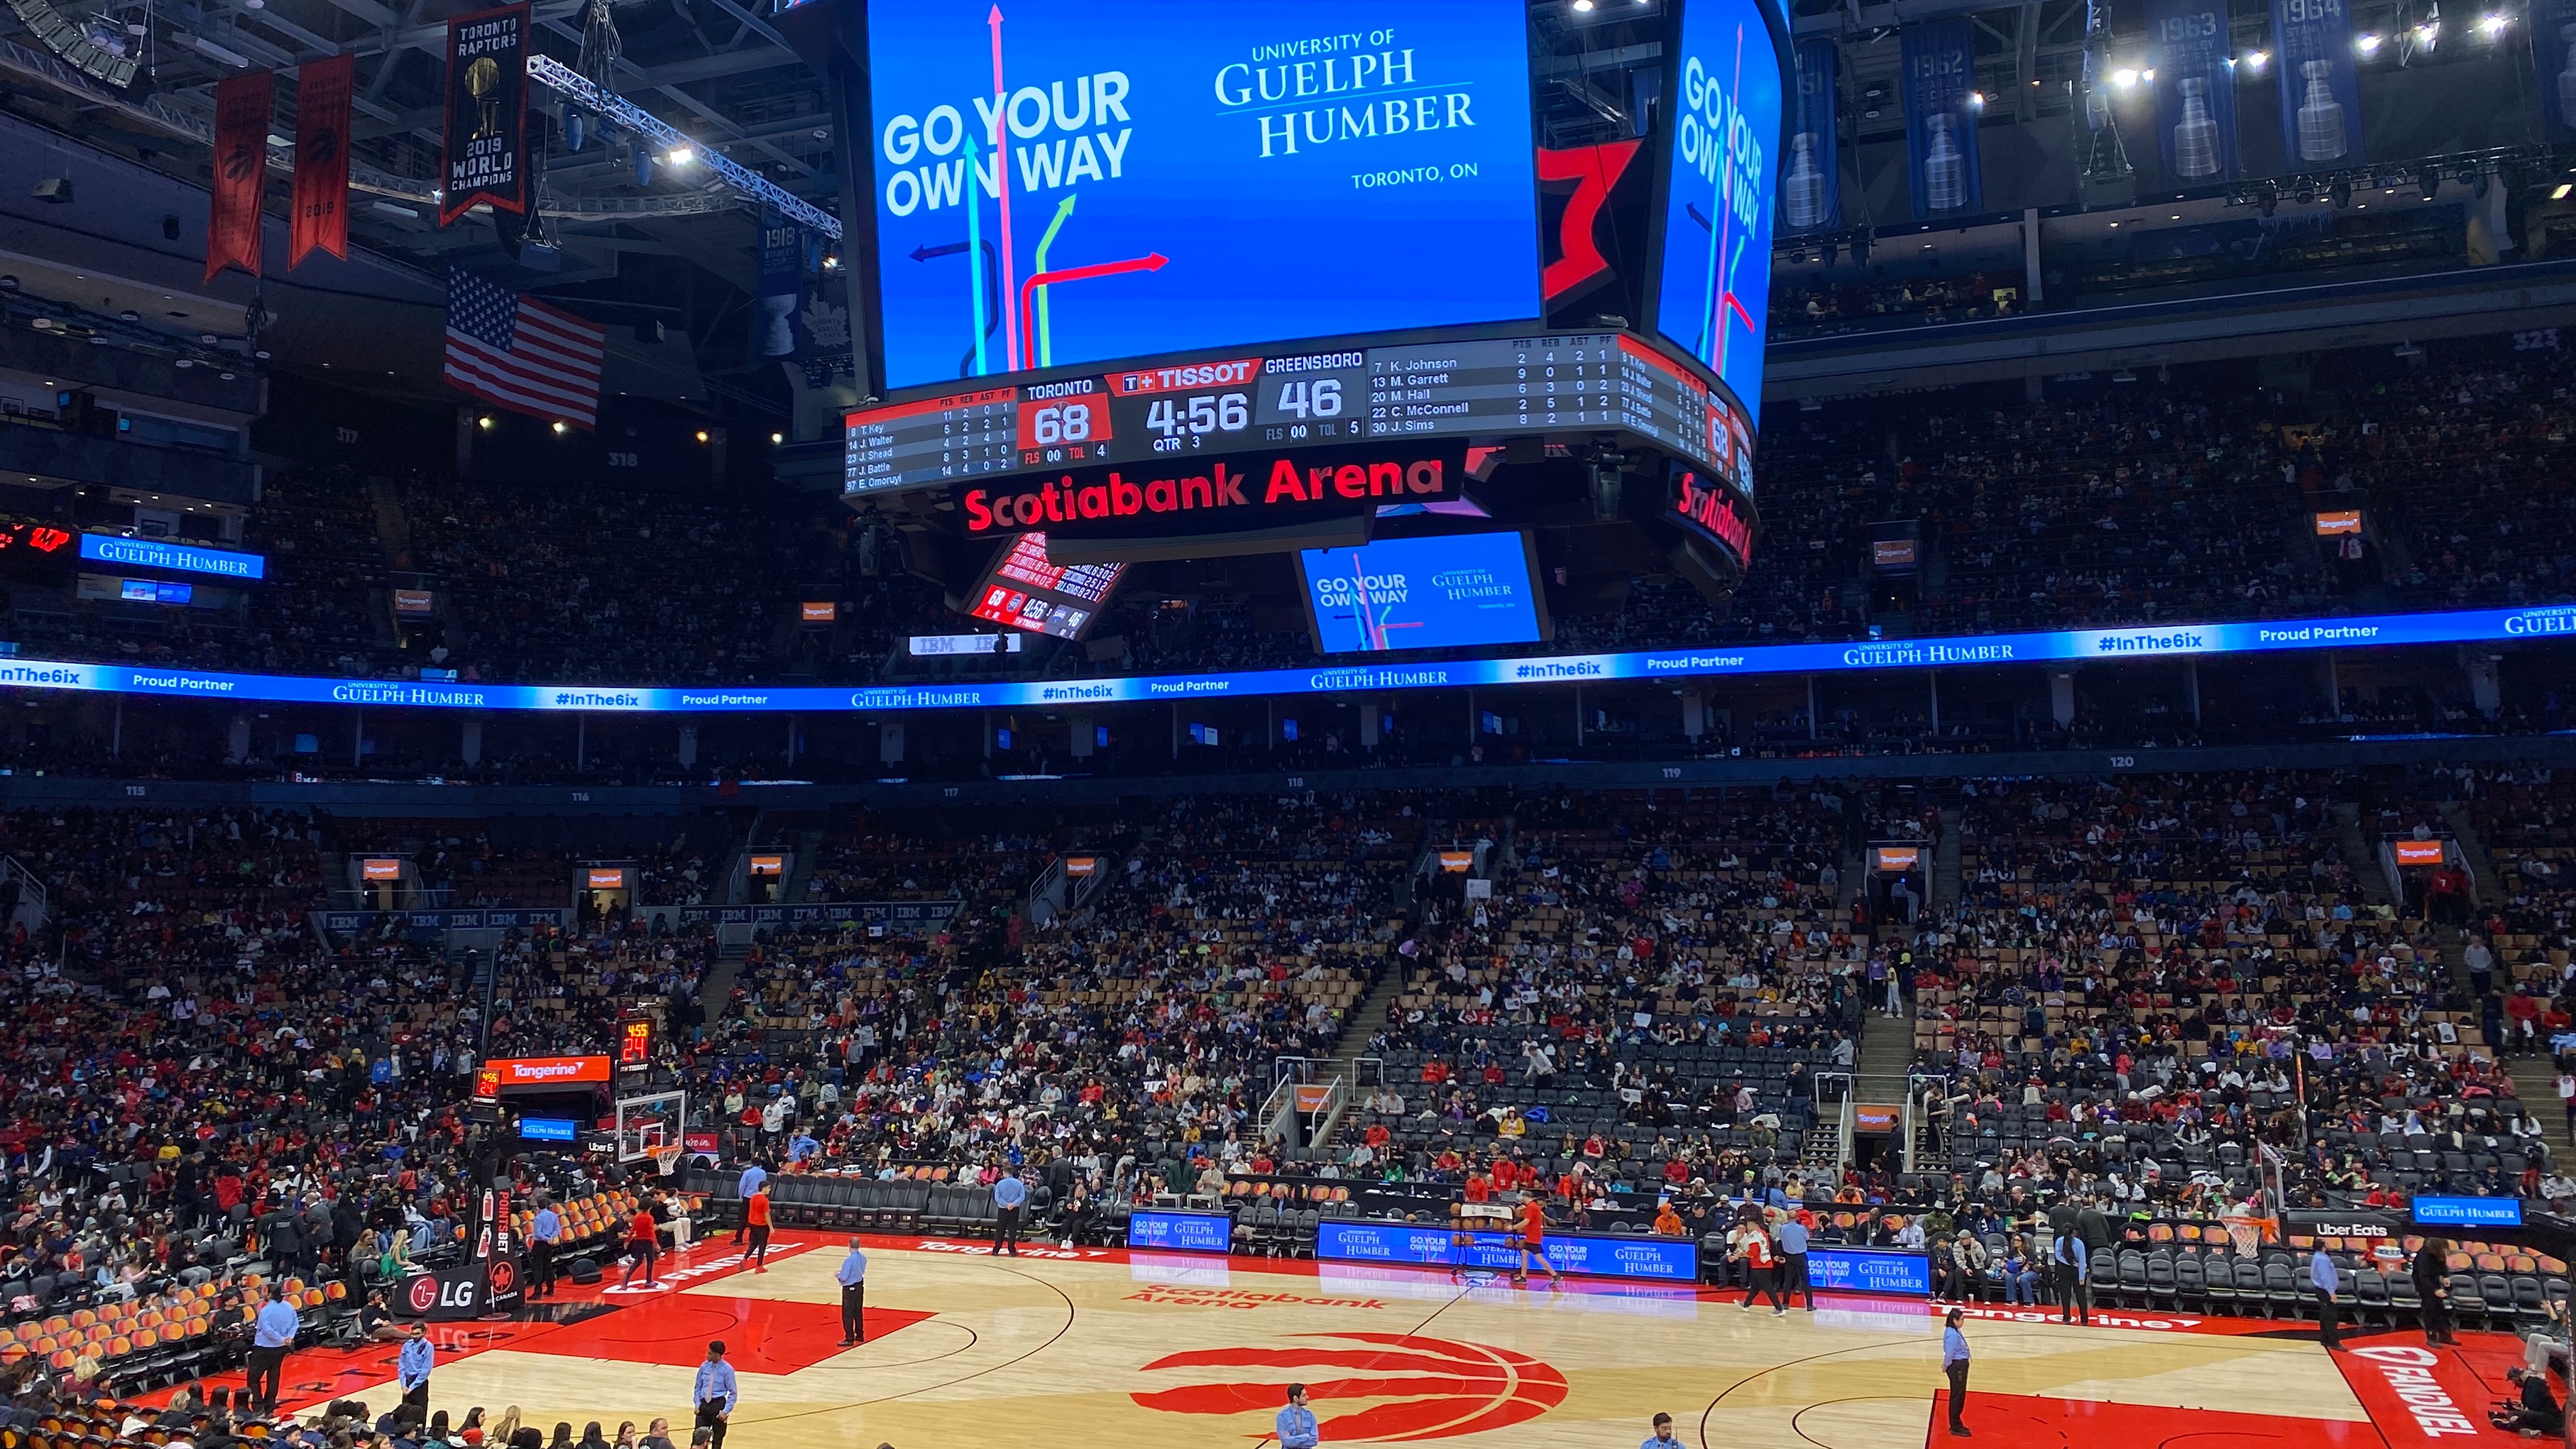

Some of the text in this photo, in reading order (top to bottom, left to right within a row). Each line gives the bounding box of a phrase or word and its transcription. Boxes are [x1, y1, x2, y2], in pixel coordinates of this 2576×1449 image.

[2281, 0, 2340, 23] 1964
[461, 18, 517, 40] TORONTO
[2159, 11, 2216, 43] 1963
[458, 33, 517, 56] RAPTORS
[1252, 29, 1395, 62] UNIVERSITY OF
[1914, 50, 1963, 78] 1962
[1214, 48, 1416, 106] GUELPH
[883, 70, 1131, 165] GO YOUR
[1258, 92, 1476, 158] HUMBER
[1685, 56, 1762, 197] GO YOUR
[466, 137, 502, 158] 2019
[452, 151, 513, 178] WORLD
[451, 171, 512, 190] CHAMPIONS
[886, 129, 1132, 217] OWN WAY
[1352, 163, 1477, 189] TORONTO, ON
[1681, 114, 1759, 241] OWN WAY
[306, 201, 334, 219] 2019
[766, 226, 795, 248] 1918
[764, 248, 795, 259] STANLEY
[772, 257, 787, 266] CUP
[1512, 335, 1611, 349] PTS REB AST PF
[2514, 329, 2557, 351] 323
[1265, 352, 1363, 374] GREENSBORO
[1375, 358, 1457, 373] 7 K. Johnson
[1157, 362, 1250, 388] TISSOT
[1371, 373, 1449, 388] 13 M. Garrett
[1027, 380, 1093, 400] TORONTO
[1278, 378, 1342, 417] 46
[1371, 389, 1430, 402] 20 M. Hall
[1146, 393, 1248, 437] 4:56
[1371, 402, 1469, 419] 22 C. McConnell
[850, 423, 884, 437] 8 T. Key
[1035, 404, 1090, 444] 68
[1372, 420, 1435, 433] 30 J. Sims
[336, 427, 358, 444] 317
[848, 434, 894, 450] 14 J. Walter
[1153, 436, 1200, 452] QTR 3
[608, 452, 638, 467] 318
[847, 448, 893, 464] 23 J. Shead
[847, 462, 890, 478] 77 J. Battle
[846, 474, 902, 491] 97 E. Omoruyi
[965, 459, 1443, 531] Scotiabank Arena
[114, 540, 157, 551] UNIVERSITY
[99, 542, 248, 575] GUELPH-HUMBER
[1316, 574, 1407, 594] GO YOUR
[1432, 574, 1493, 587] GUELPH
[988, 589, 1007, 607] 68
[1320, 589, 1408, 607] OWN WAY
[1447, 585, 1513, 601] HUMBER
[1068, 611, 1084, 628] 46
[2099, 632, 2203, 651] #InThe6ix
[2259, 625, 2379, 643] Proud Partner
[920, 637, 955, 652] IBM
[1858, 643, 1901, 652] UNIVERSITY
[1648, 654, 1744, 670] Proud Partner
[1843, 644, 2015, 666] GUELPH-HUMBER
[1, 667, 80, 684] nThe6ix
[1516, 662, 1601, 678] #InThe6ix
[133, 674, 234, 691] Proud Partner
[1151, 679, 1229, 693] Proud Partner
[1311, 669, 1448, 689] GUELPH-HUMBER
[333, 685, 484, 706] GUELPH-HUMBER
[556, 693, 639, 707] #InThe6ix
[683, 694, 768, 705] Proud Partner
[852, 691, 981, 708] GUELPH-HUMBER
[1043, 684, 1113, 700] #InThe6ix
[2110, 756, 2134, 767] 120
[1662, 767, 1682, 779] 119
[1287, 777, 1304, 787] 118
[126, 785, 146, 797] 115
[571, 792, 590, 802] 116
[943, 787, 959, 797] 117
[2399, 848, 2435, 858] Tangerine
[412, 915, 439, 927] IBM
[451, 914, 478, 926] IBM
[490, 913, 517, 925] IBM
[720, 909, 746, 921] IBM
[757, 909, 782, 921] IBM
[897, 907, 921, 919] IBM
[627, 1024, 648, 1037] 4:55
[623, 1037, 646, 1062] 24
[512, 1063, 576, 1079] Tangerine
[588, 1143, 607, 1152] Uber
[498, 1191, 510, 1254] POINTSBET
[1174, 1223, 1213, 1235] GUELPH
[2316, 1223, 2388, 1237] Uber Eats
[1181, 1235, 1223, 1246] HUMBER
[1338, 1232, 1380, 1245] GUELPH
[1346, 1245, 1391, 1256] HUMBER
[1615, 1249, 1662, 1262] GUELPH
[1624, 1262, 1674, 1274] HUMBER
[1808, 1259, 1850, 1269] GO YOUR
[1809, 1267, 1850, 1277] OWN WAY
[1858, 1262, 1909, 1276] GUELPH
[1870, 1276, 1923, 1289] HUMBER
[440, 1281, 474, 1307] LG
[495, 1291, 517, 1302] CANADA
[1122, 1293, 1261, 1309] Arena
[1139, 1284, 1392, 1309] Scotiabank
[2379, 1365, 2478, 1438] FANDUEL
